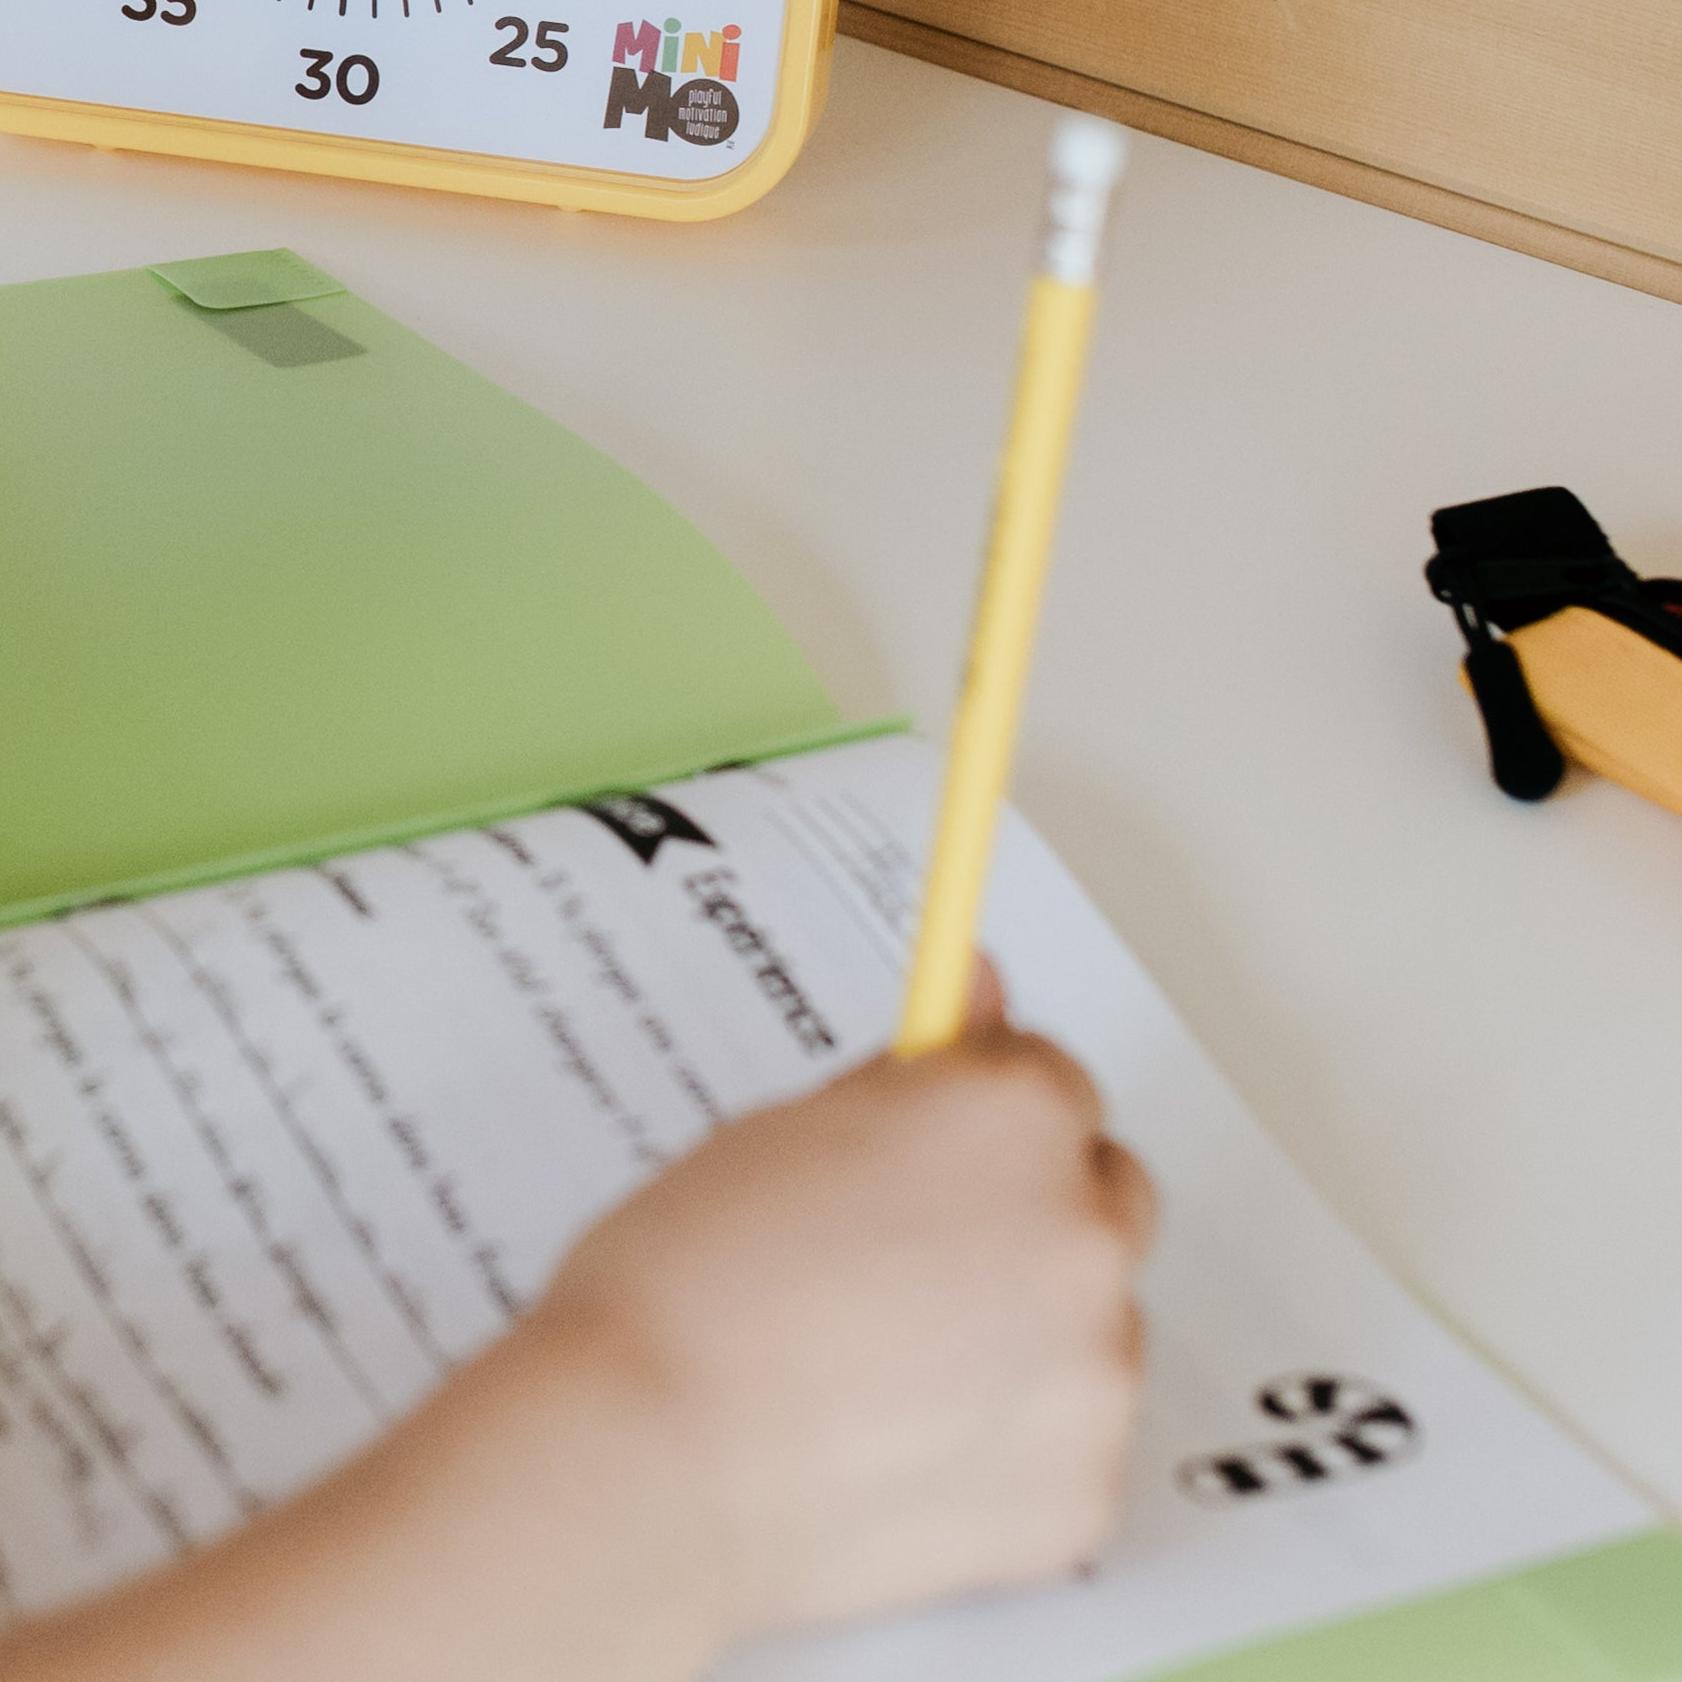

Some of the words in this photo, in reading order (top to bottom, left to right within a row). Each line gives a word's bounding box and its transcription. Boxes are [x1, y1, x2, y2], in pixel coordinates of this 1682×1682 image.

[489, 16, 570, 73] 25
[294, 48, 380, 106] 30
[688, 88, 722, 108] playful
[678, 107, 728, 123] motivation
[685, 121, 720, 140] ludique
